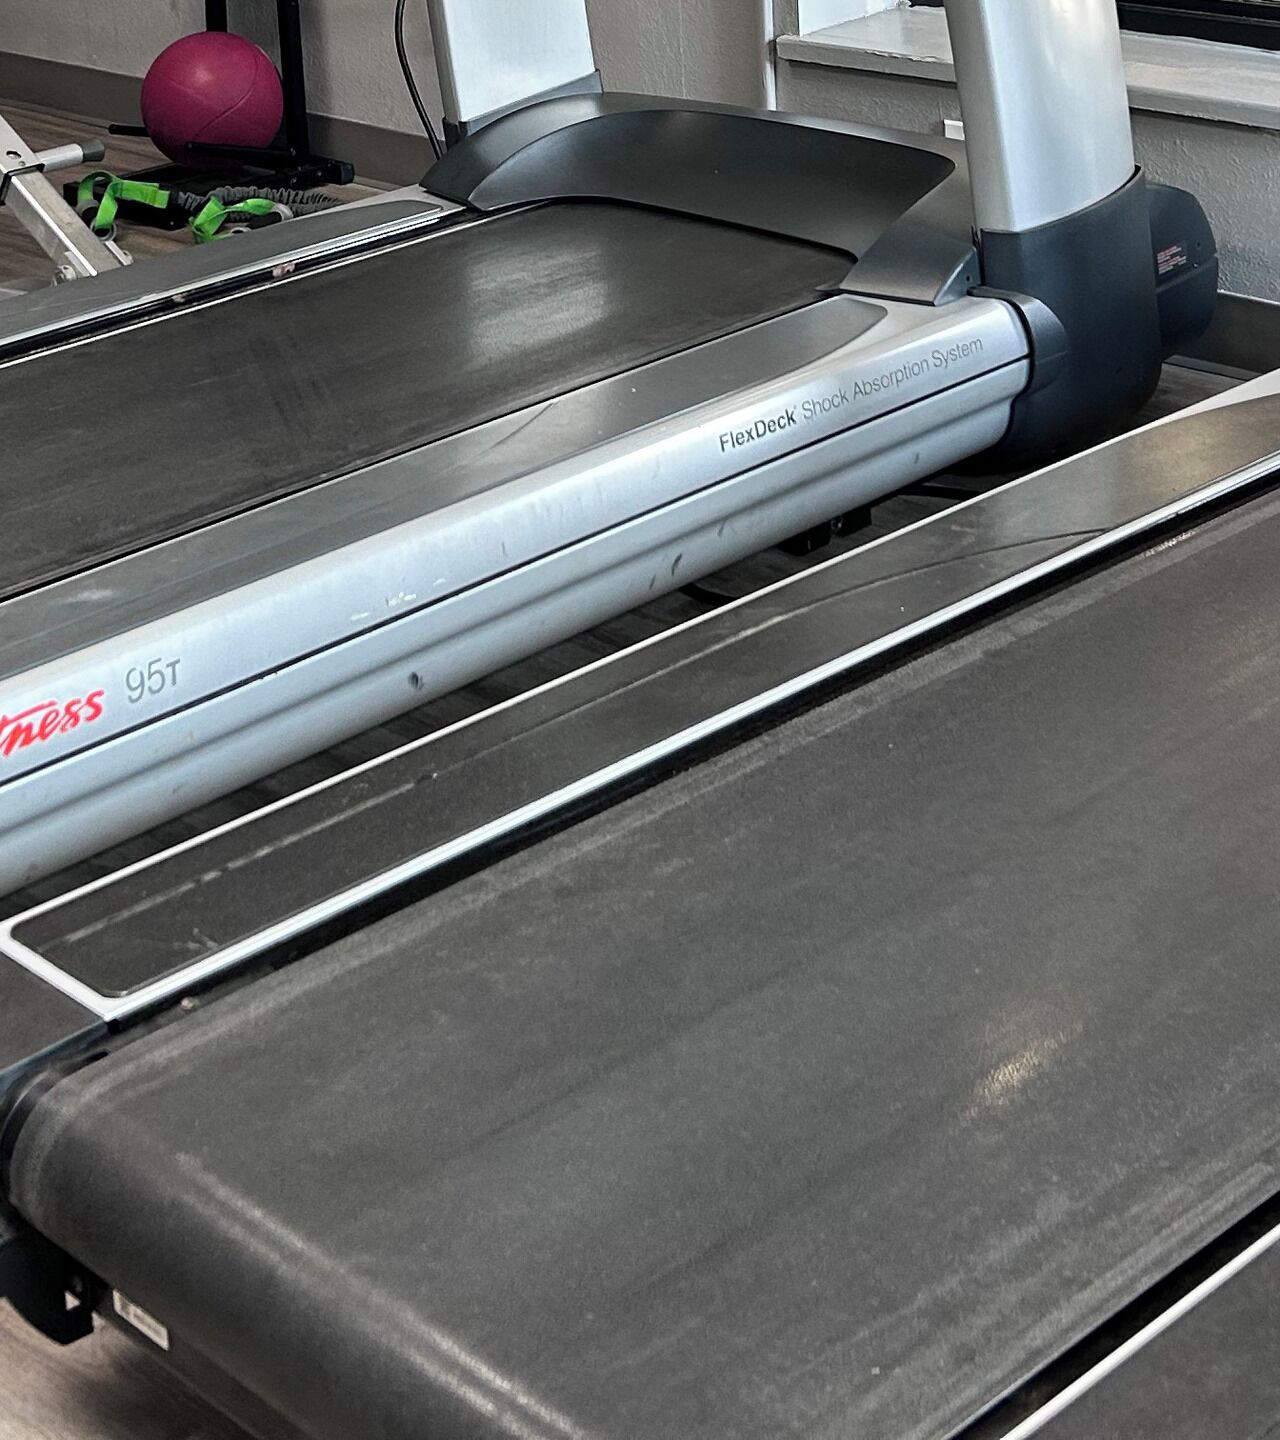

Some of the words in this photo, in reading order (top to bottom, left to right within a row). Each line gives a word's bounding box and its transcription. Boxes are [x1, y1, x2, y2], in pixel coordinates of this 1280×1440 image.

[802, 389, 849, 420] Shock
[852, 357, 931, 400] Absorption
[931, 338, 984, 370] System
[125, 657, 182, 704] 95T
